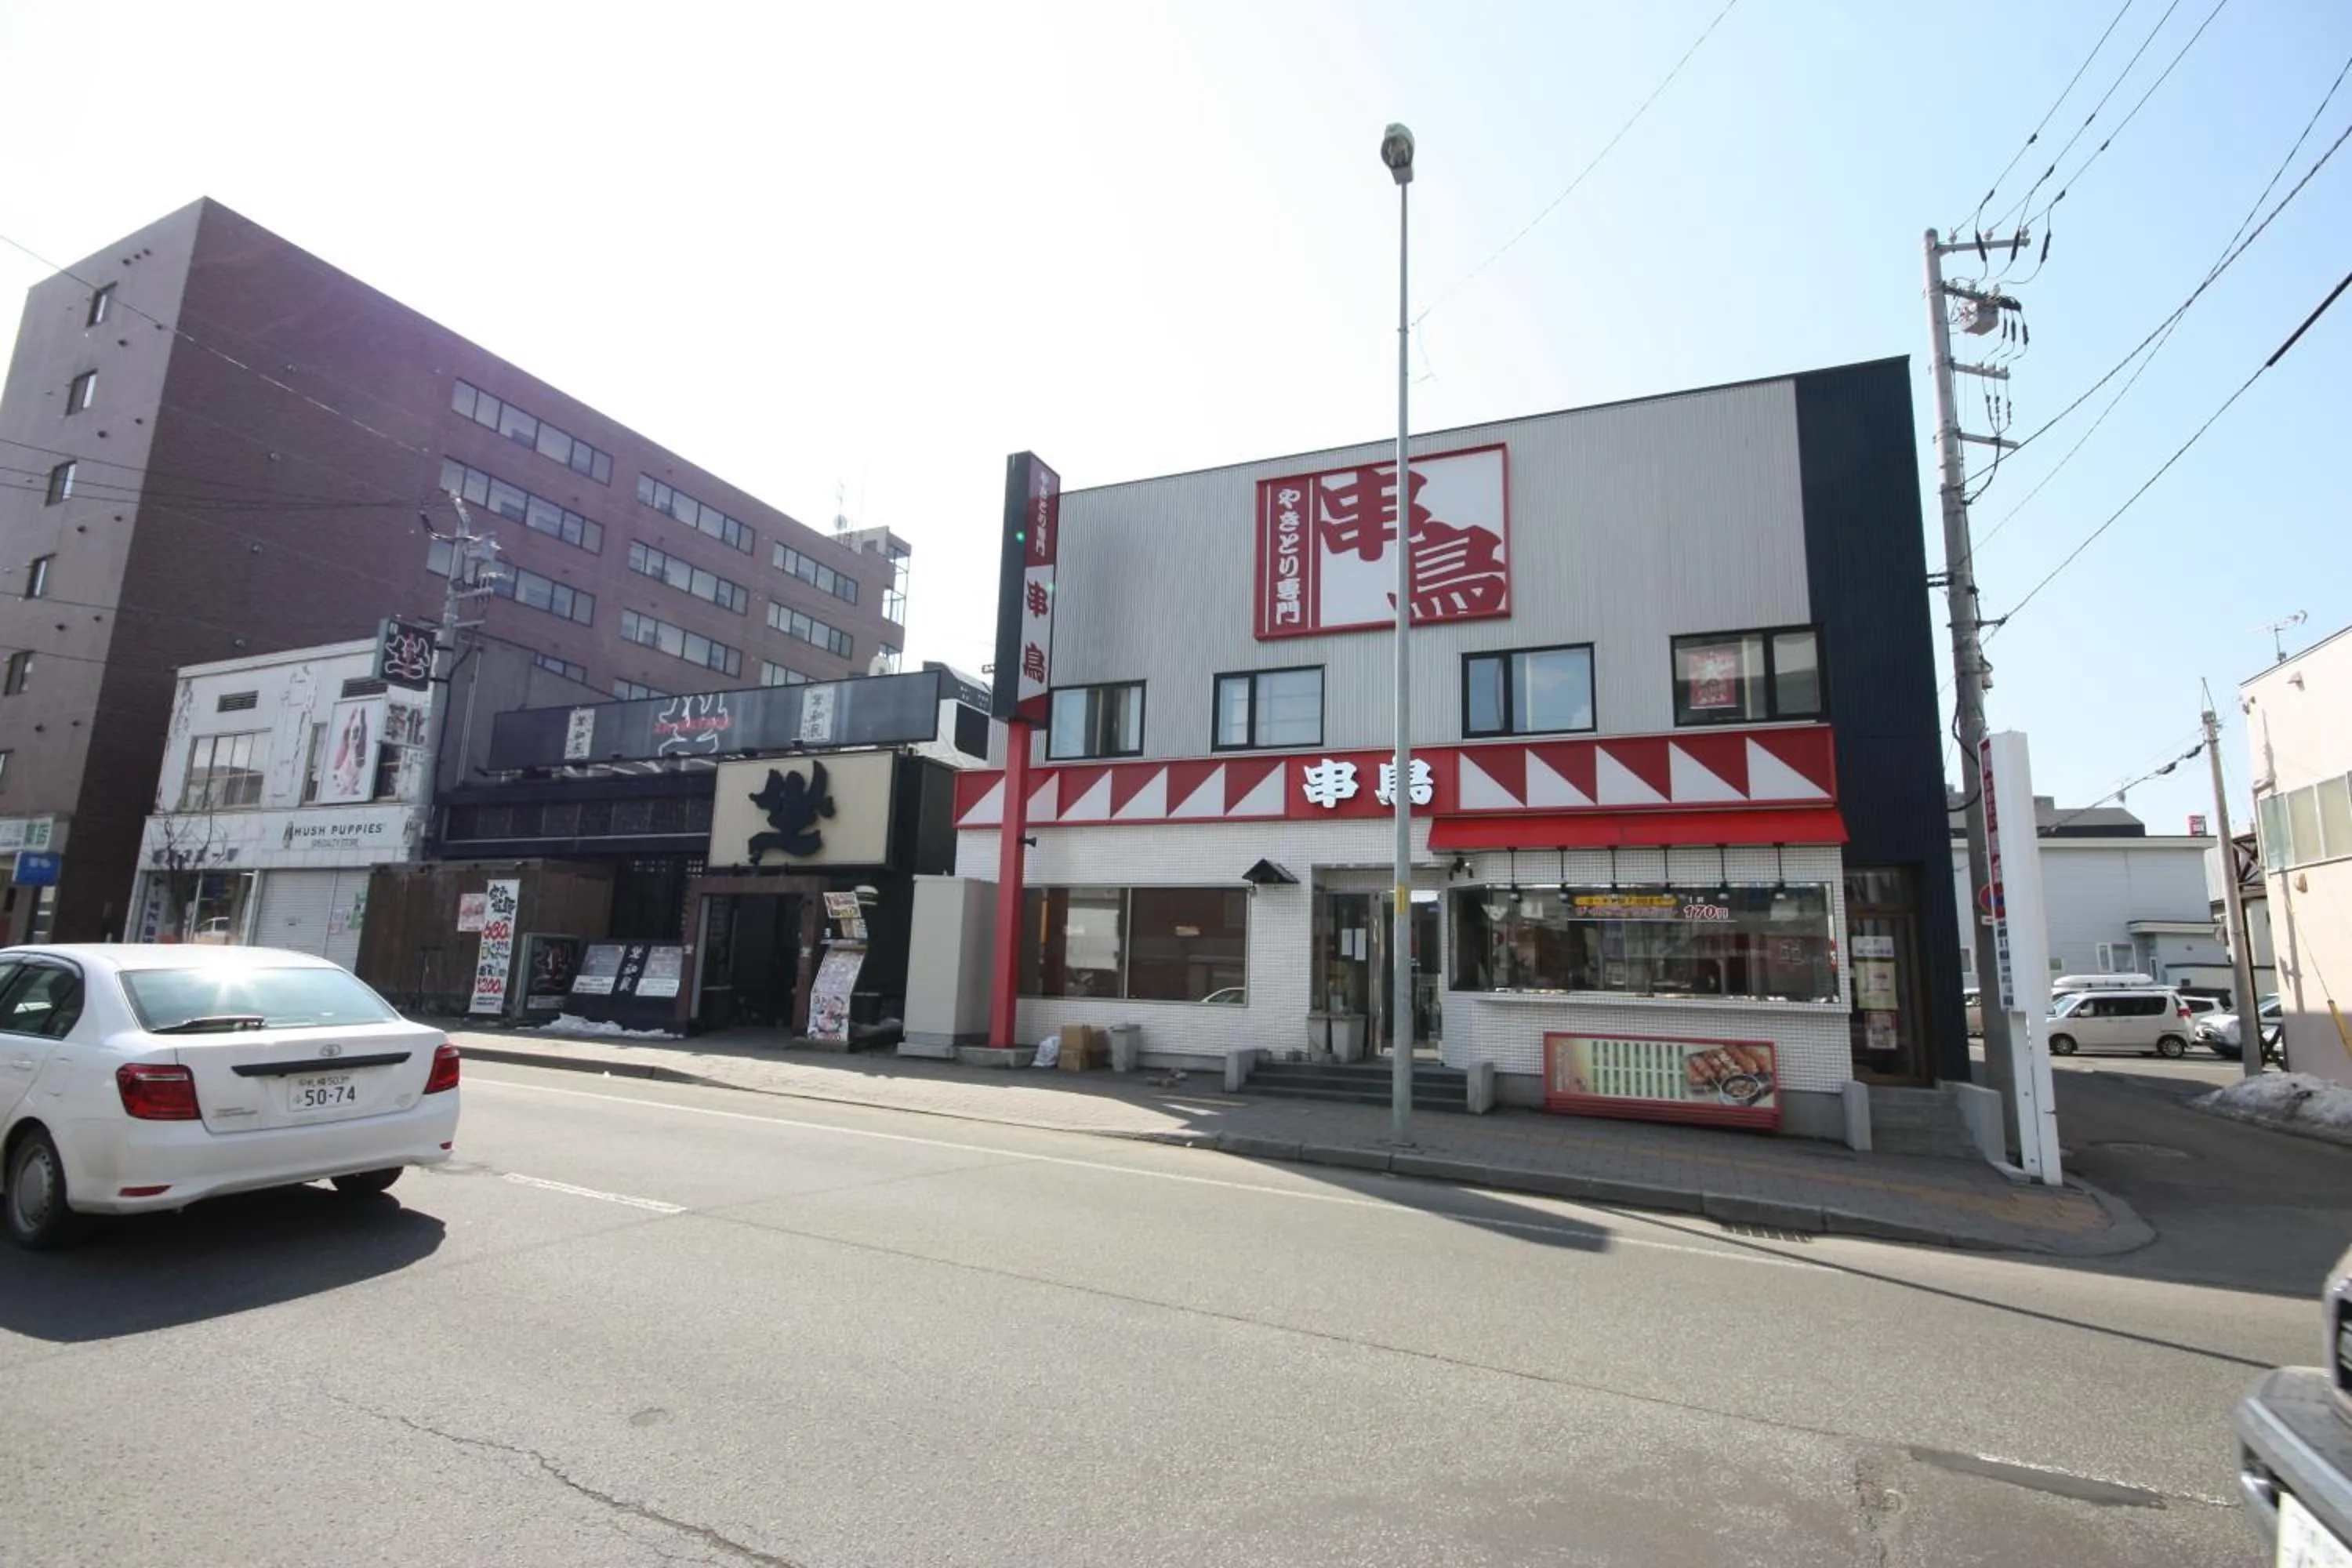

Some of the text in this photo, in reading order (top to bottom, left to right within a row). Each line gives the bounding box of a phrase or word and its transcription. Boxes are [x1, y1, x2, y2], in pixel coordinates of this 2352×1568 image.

[1022, 579, 1049, 684] 串鳥
[1302, 756, 1434, 809] 串鳥
[294, 823, 383, 837] HUSH PUPPIES
[305, 1085, 355, 1106] 50-74
